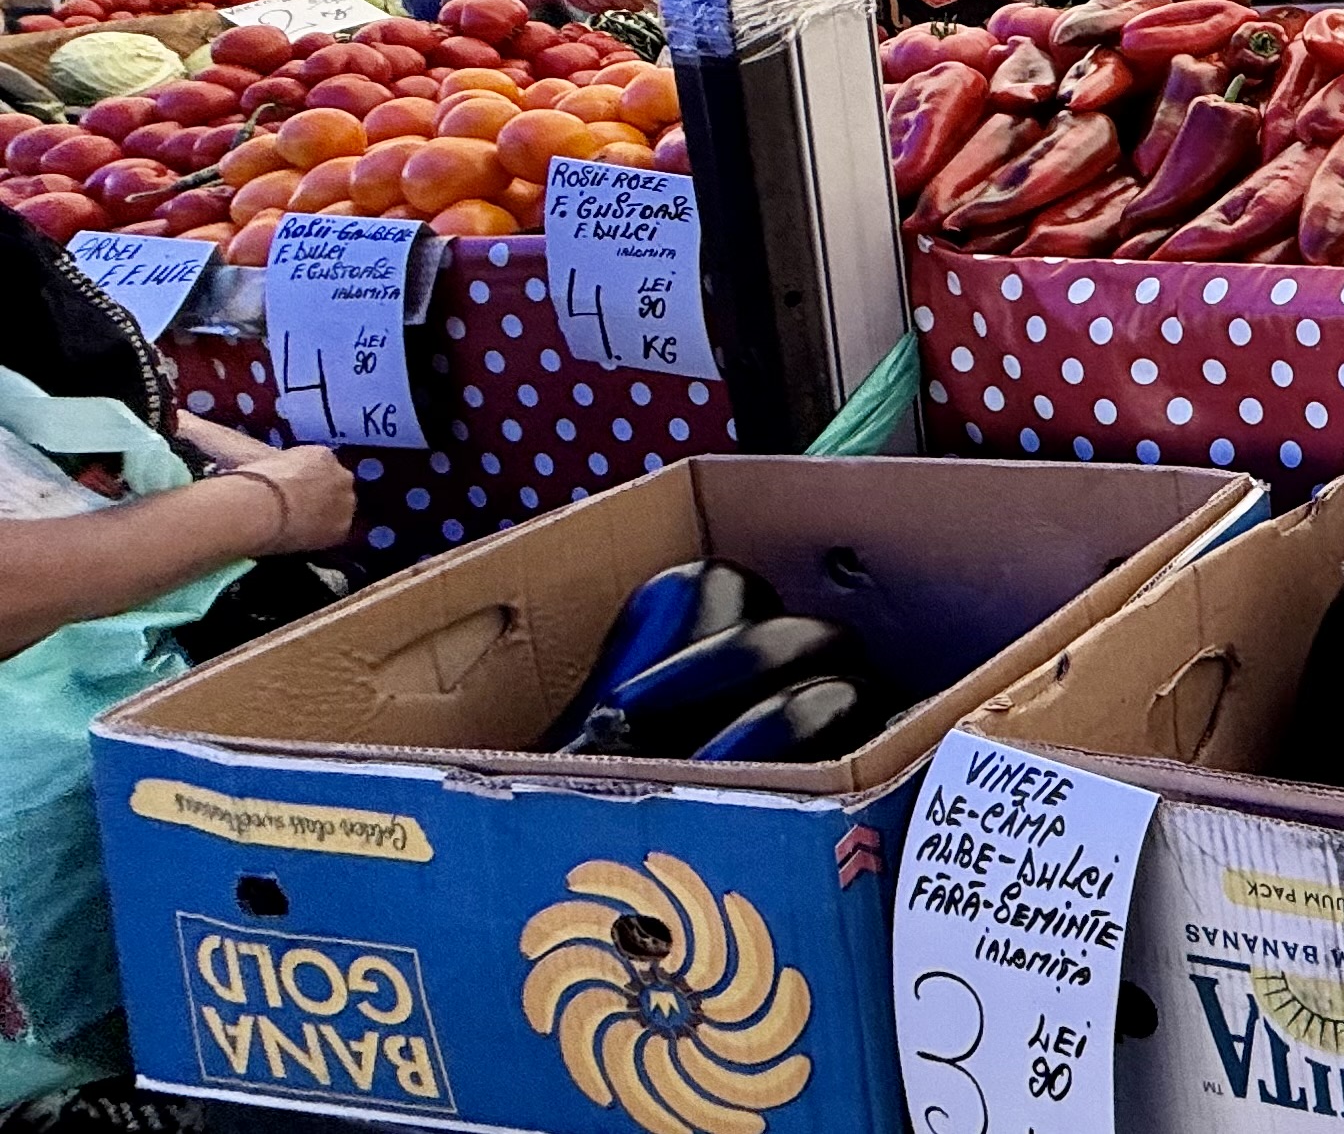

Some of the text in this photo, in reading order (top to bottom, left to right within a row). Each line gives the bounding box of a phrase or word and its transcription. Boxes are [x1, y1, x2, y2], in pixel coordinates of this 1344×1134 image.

[638, 270, 677, 294] LEI
[638, 295, 666, 319] 90
[353, 325, 389, 350] LEI
[642, 334, 677, 364] KG
[353, 351, 378, 374] 90
[362, 402, 398, 438] KG
[1245, 880, 1297, 905] PACK
[1184, 923, 1319, 964] BANANAS
[197, 932, 415, 1027] GOLD
[200, 1004, 441, 1099] BANA
[1028, 1013, 1092, 1059] LEI
[1028, 1056, 1073, 1102] 90
